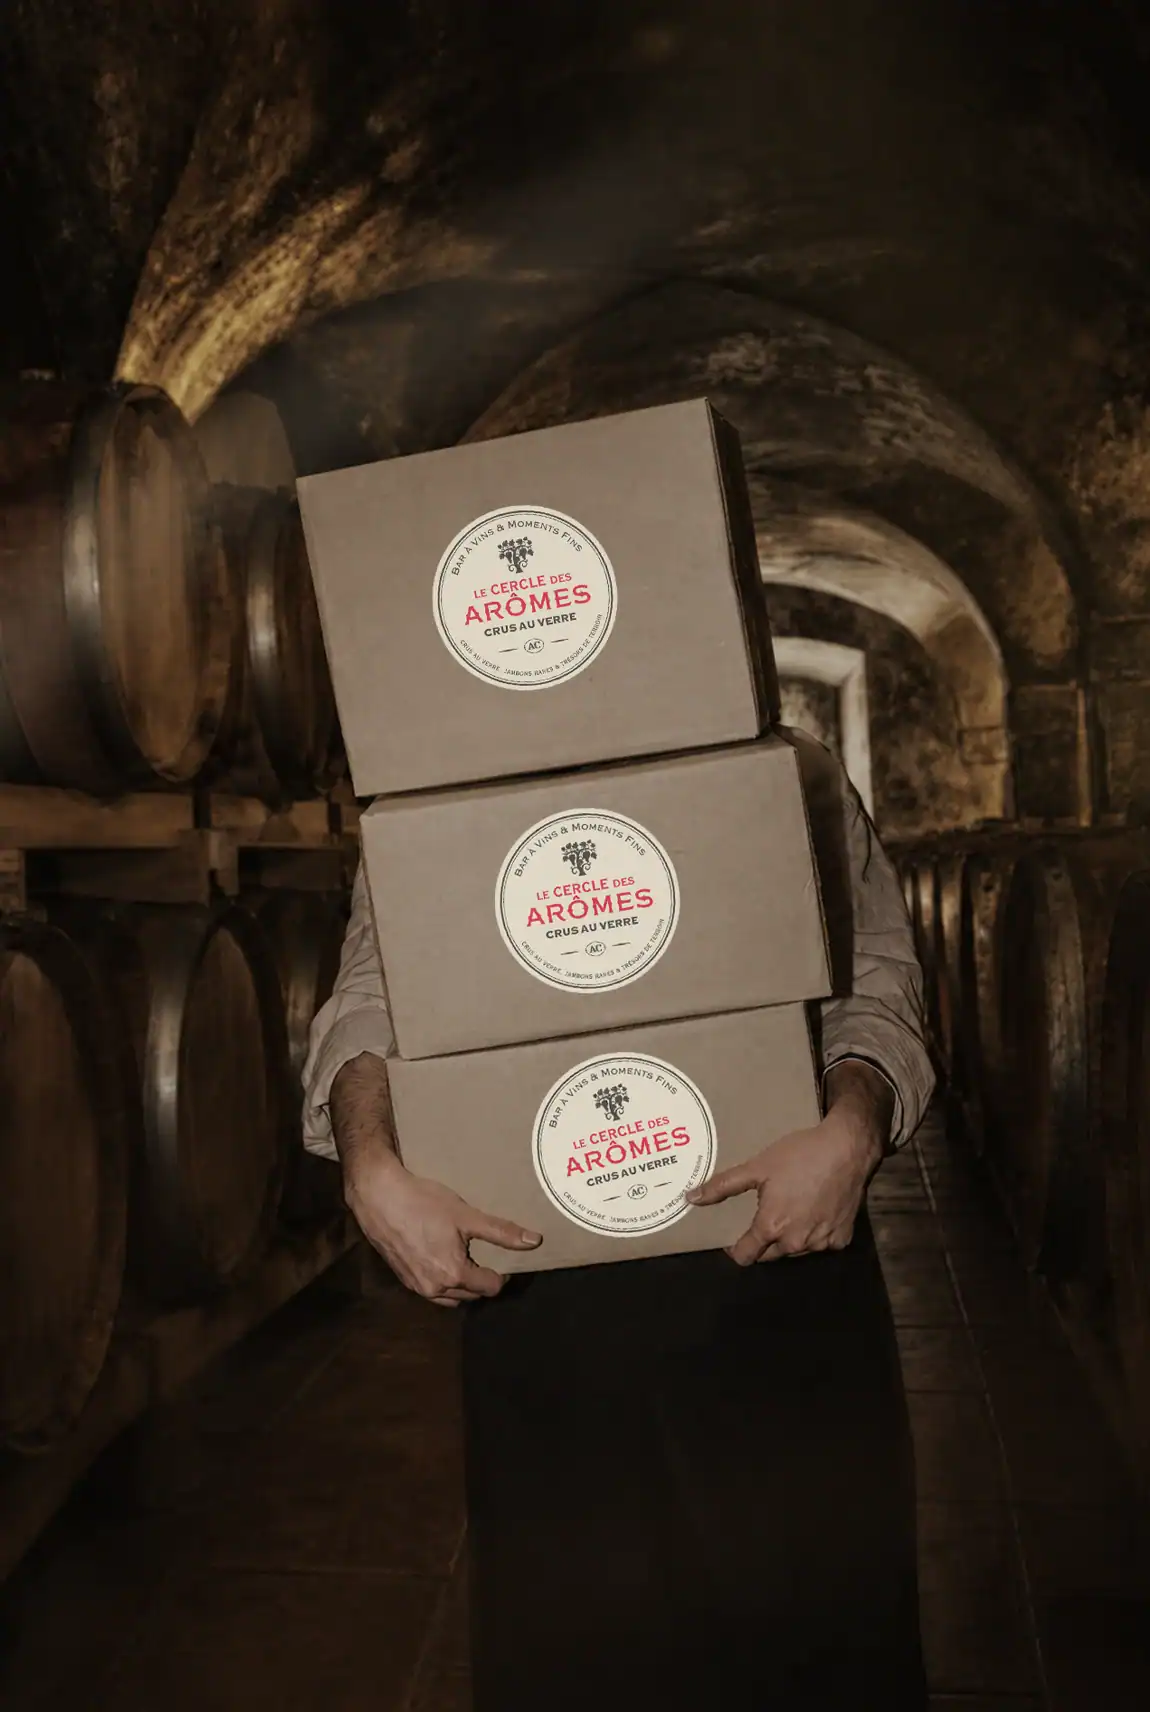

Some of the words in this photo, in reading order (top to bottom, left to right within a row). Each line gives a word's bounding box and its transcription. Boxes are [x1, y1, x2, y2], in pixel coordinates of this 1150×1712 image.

[471, 528, 495, 547] VINS
[497, 524, 505, 532] &
[508, 520, 560, 535] MOMENTS
[561, 532, 583, 552] FINS
[474, 589, 486, 598] LE
[491, 576, 546, 595] CERCLE
[550, 573, 572, 584] DES
[465, 584, 592, 625] ARÔMES
[484, 625, 517, 637] CRUS
[518, 620, 535, 630] AU
[538, 613, 576, 627] VERRE
[535, 831, 558, 848] VINS
[572, 823, 623, 838] MOMENTS
[625, 835, 646, 856] FINS
[537, 891, 549, 900] LE
[553, 879, 608, 897] CERCLE
[612, 877, 635, 887] DES
[527, 889, 654, 927] ARÔMES
[546, 927, 579, 939] CRUS
[580, 923, 597, 934] AU
[600, 917, 639, 930] VERRE
[566, 1080, 589, 1097] VINS
[590, 1073, 598, 1082] &
[601, 1068, 653, 1080] MOMENTS
[655, 1075, 678, 1095] FINS
[573, 1139, 586, 1149] LE
[589, 1120, 644, 1144] CERCLE
[648, 1116, 670, 1129] DES
[566, 1127, 690, 1177] ARÔMES
[587, 1175, 619, 1186] CRUS
[621, 1167, 637, 1178] AU
[639, 1155, 678, 1172] VERRE
